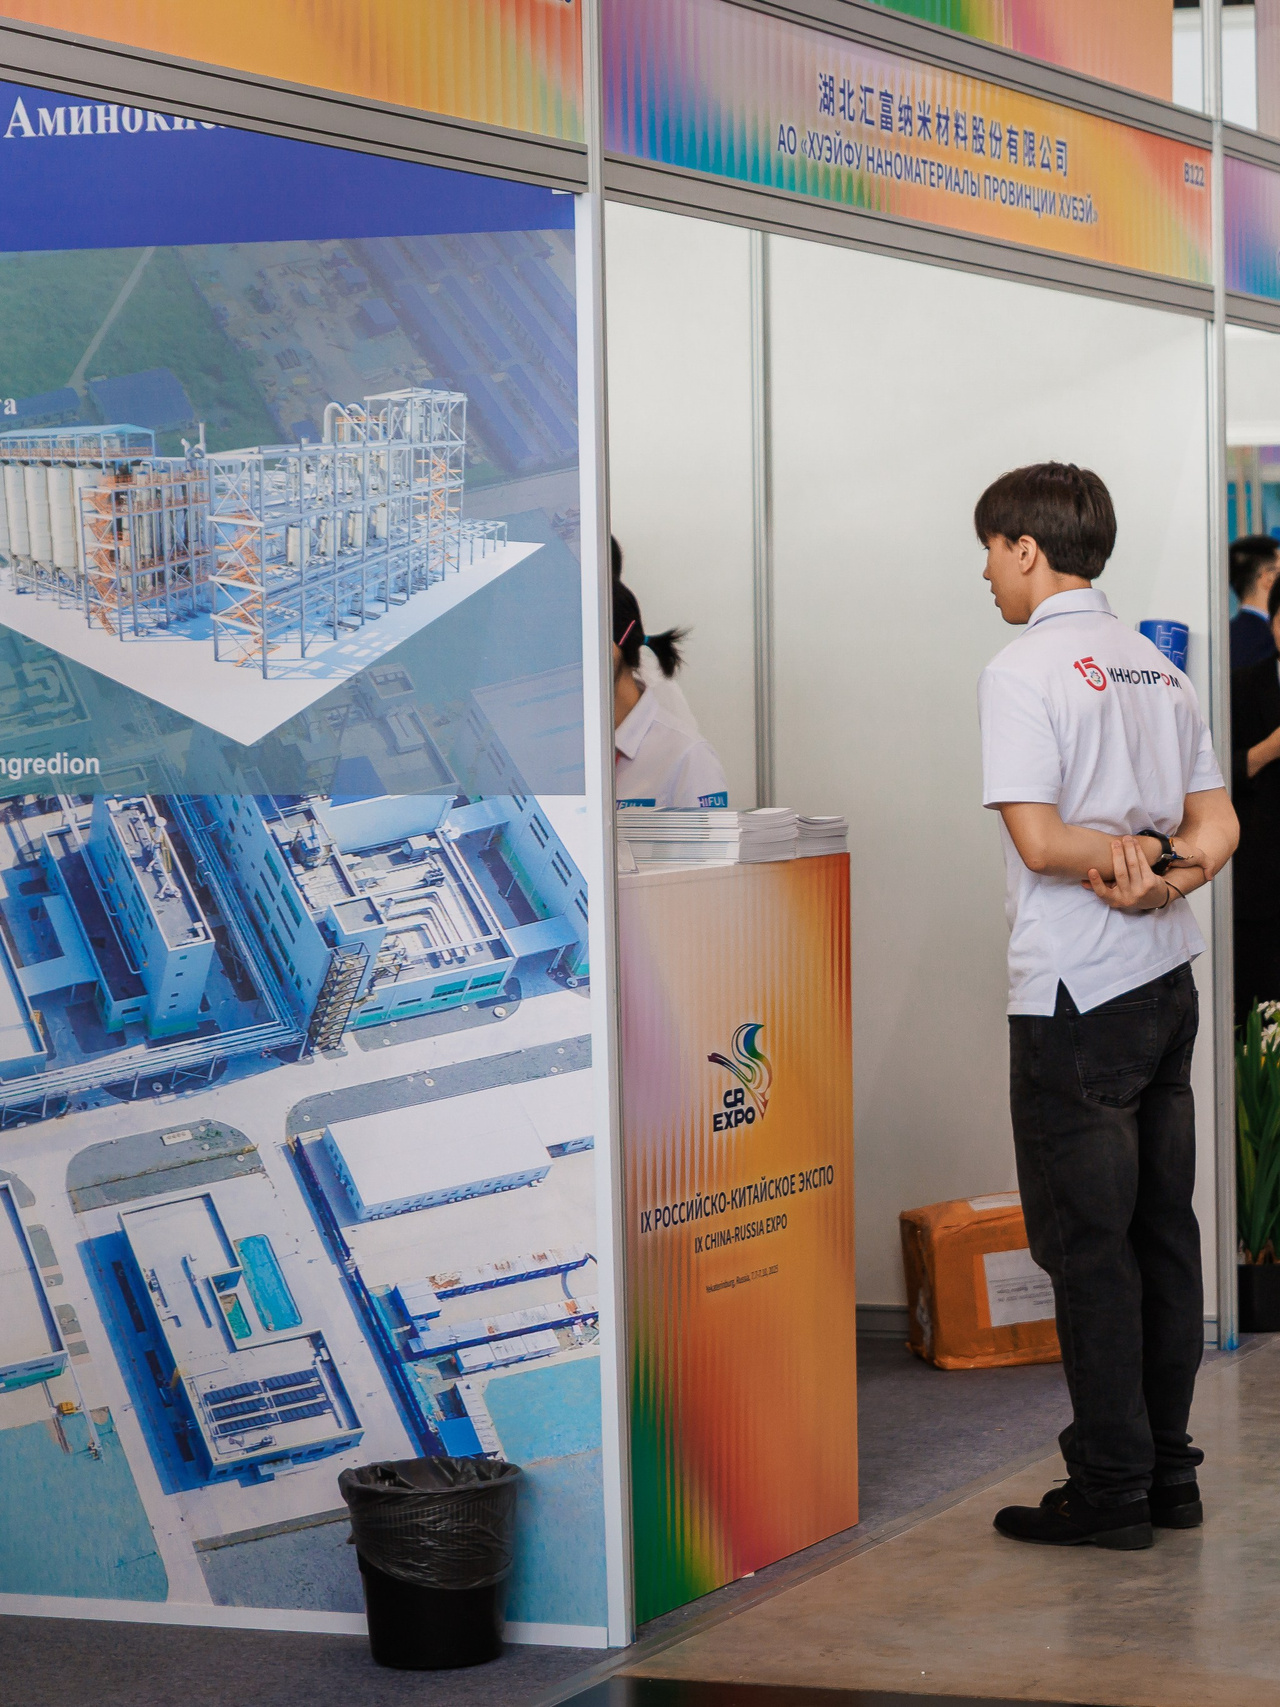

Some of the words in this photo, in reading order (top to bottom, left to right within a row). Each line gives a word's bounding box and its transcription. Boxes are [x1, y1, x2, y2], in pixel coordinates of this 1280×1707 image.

[3, 95, 229, 138] Аминок
[818, 72, 1069, 177] 湖北汇富纳米材料股份有限公司
[777, 123, 797, 155] АО
[801, 130, 863, 170] «ХУЭЙФУ
[866, 145, 981, 199] НАНОМАТЕРИАЛЫ
[984, 174, 1057, 219] ПРОВИНЦИИ
[1058, 193, 1099, 224] ХУБЭЙ»
[1073, 656, 1107, 691] 15
[1106, 667, 1183, 689] ИННОПРОМ
[723, 1088, 745, 1108] CR
[713, 1106, 756, 1132] EXPO
[640, 1211, 652, 1234] IX
[654, 1174, 796, 1231] РОССИЙСКО-КИТАЙСКОЕ
[798, 1165, 834, 1193] ЭКСПО
[694, 1236, 704, 1254] IX
[705, 1220, 765, 1250] CHINA-RUSSIA
[766, 1213, 788, 1234] EXPO
